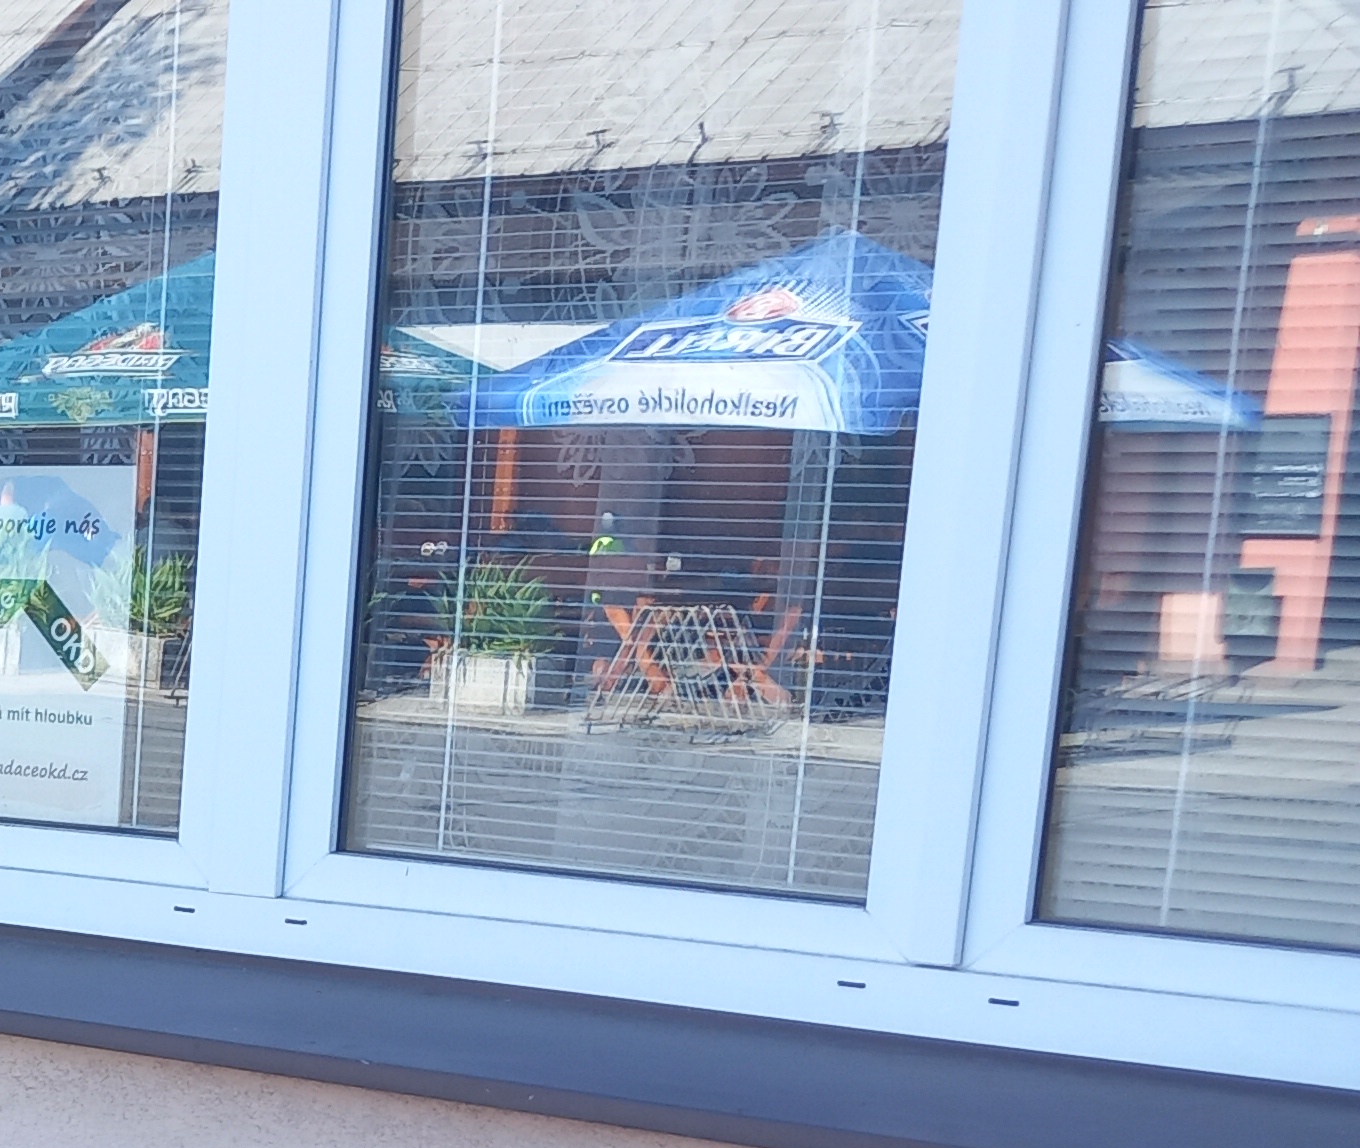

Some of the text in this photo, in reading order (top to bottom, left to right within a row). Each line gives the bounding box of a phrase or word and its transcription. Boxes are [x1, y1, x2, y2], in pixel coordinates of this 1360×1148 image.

[64, 512, 101, 535] nás
[50, 617, 95, 675] OKD
[7, 706, 32, 722] mít
[34, 708, 93, 726] hloubku
